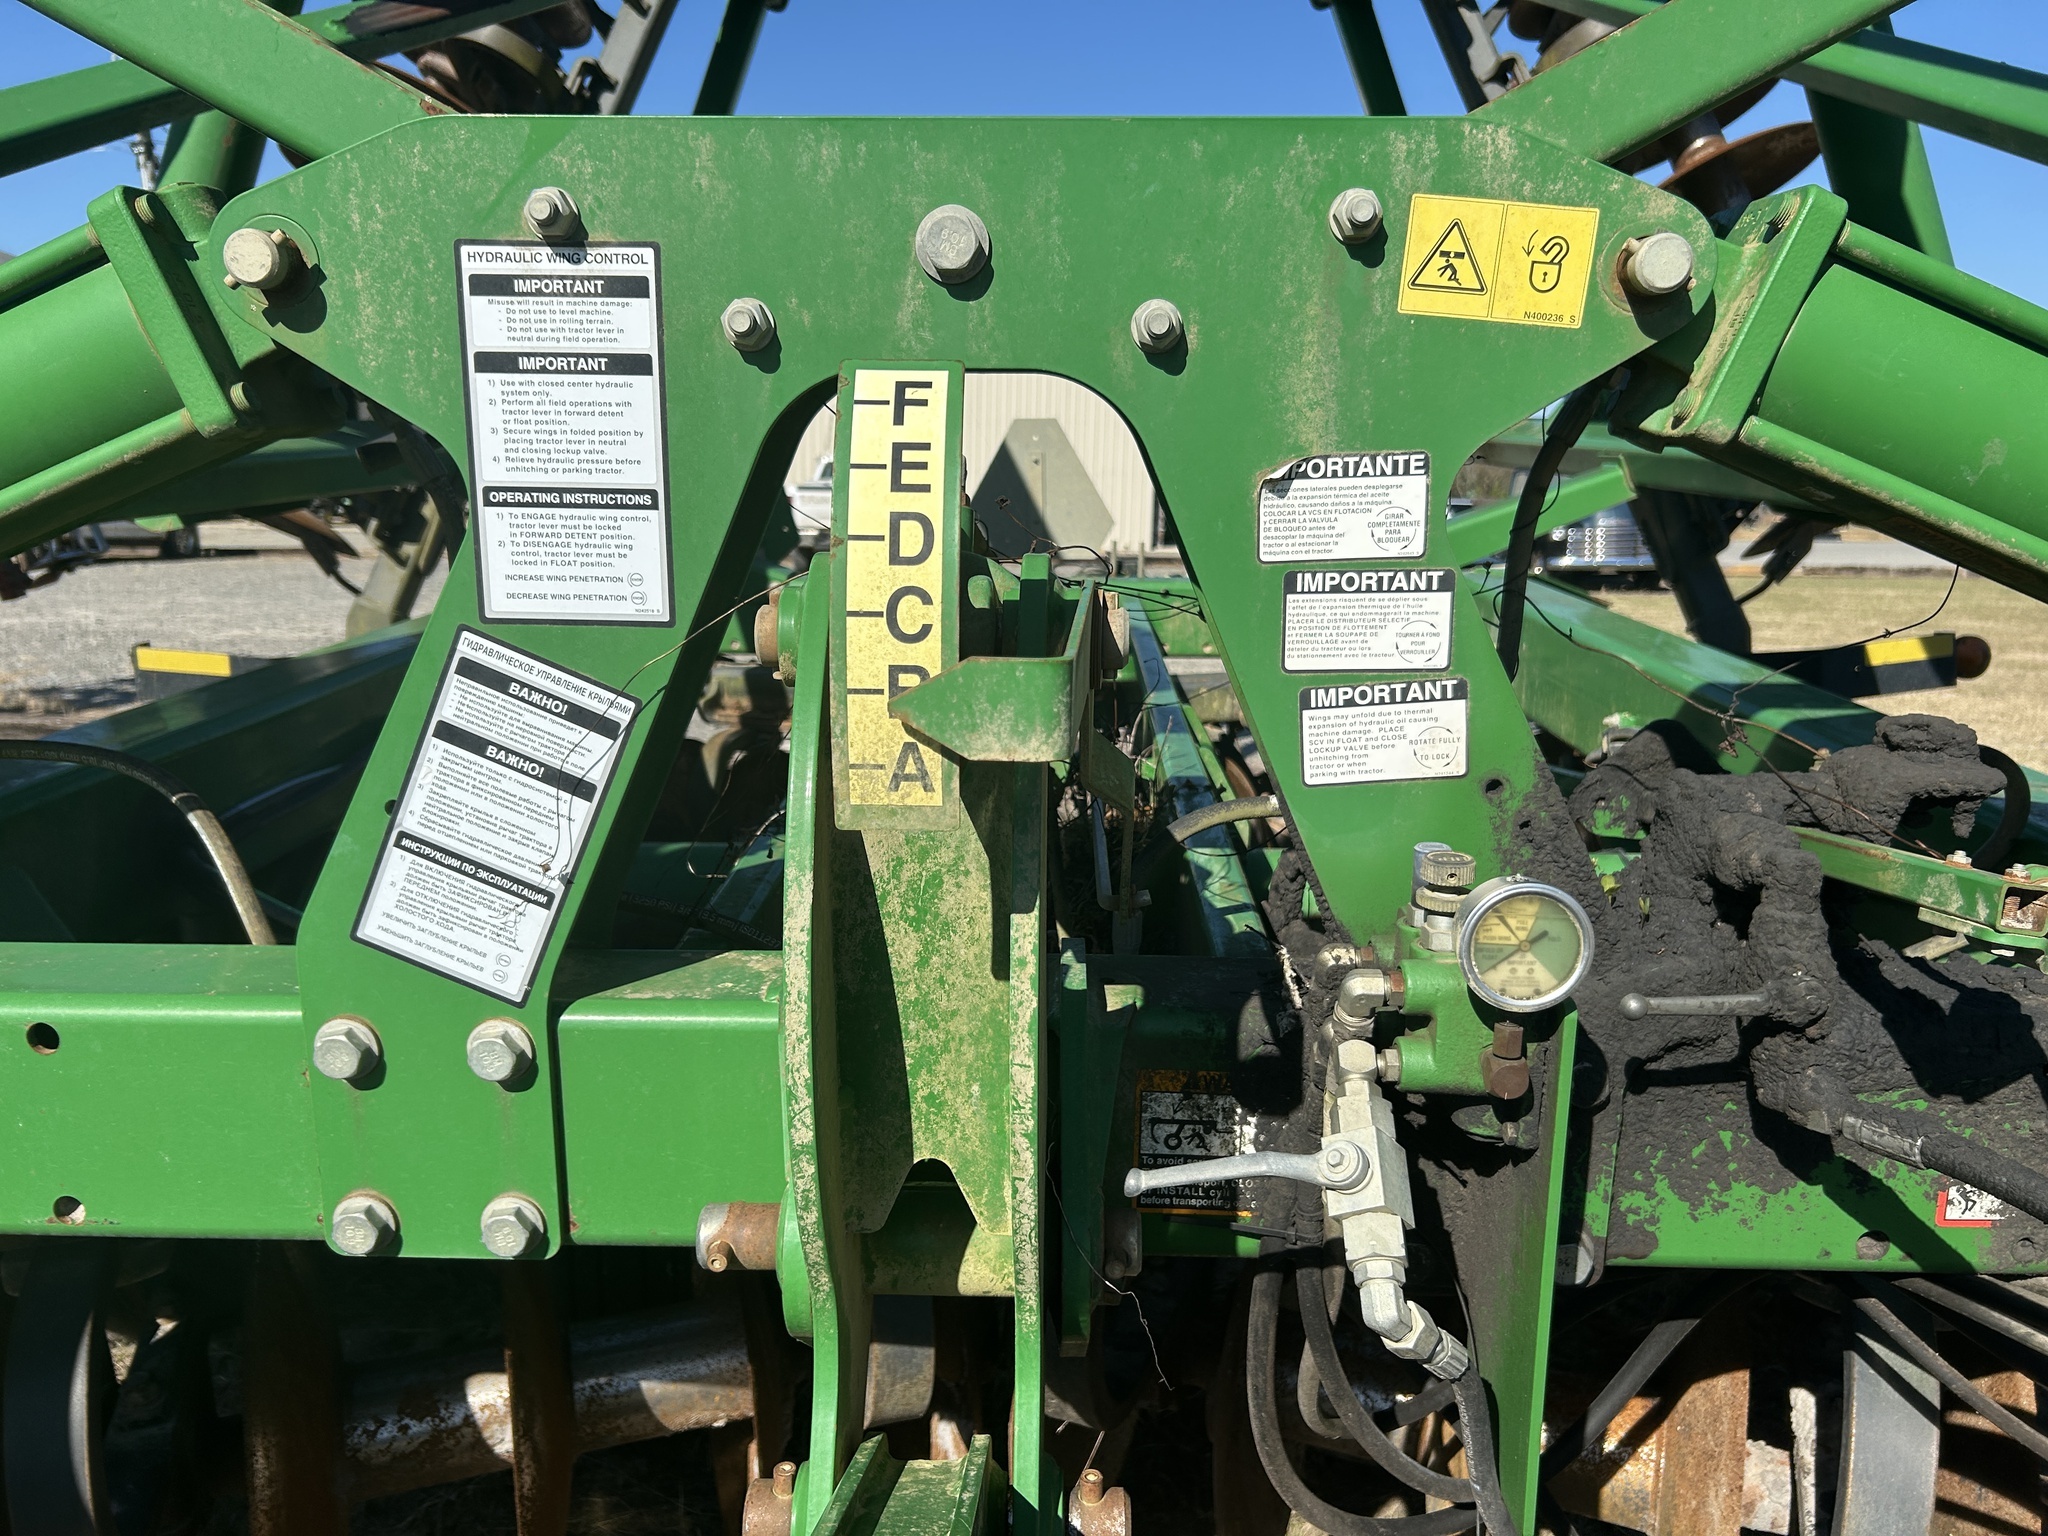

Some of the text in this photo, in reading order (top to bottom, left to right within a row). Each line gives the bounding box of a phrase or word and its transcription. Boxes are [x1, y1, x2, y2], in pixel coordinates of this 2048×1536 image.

[467, 251, 648, 264] HYDRAULIC WING CONTROL
[513, 278, 604, 294] IMPORTANT
[599, 300, 632, 308] damage:
[558, 317, 583, 326] rolling
[1524, 311, 1576, 324] N400236 S
[535, 335, 560, 343] during
[518, 356, 608, 370] IMPORTANT
[487, 378, 495, 387] 1)
[595, 380, 633, 389] hydraulic
[893, 381, 933, 426] F
[890, 442, 931, 492] E
[1284, 454, 1426, 479] PORTANTE
[488, 491, 652, 505] OPERATING INSTRUCTIONS
[496, 512, 503, 520] 1)
[558, 513, 596, 522] hydraulic
[598, 514, 617, 523] wing
[1367, 520, 1420, 528] COMPLETAMENTE
[889, 512, 934, 566] D
[568, 575, 623, 583] PENETRATION
[1296, 570, 1445, 592] IMPORTANT
[572, 593, 627, 601] PENETRATION
[886, 586, 933, 644] C
[462, 636, 632, 716] ГИДРАВЛИЧЕСКОЕ УПРАВЛЕНИЕ КРЫЛЬЯМИ
[507, 681, 568, 715] ВАЖНО!
[1310, 679, 1458, 708] IMPORTANT
[1358, 718, 1394, 727] hydraulic
[1380, 733, 1407, 741] CLOSE
[1408, 737, 1436, 745] ROTATE
[485, 744, 544, 777] ВАЖНО!
[888, 742, 935, 792] A
[400, 837, 547, 904] ИНСТРУКЦИИ ПО ЭКСПЛУАТАЦИИ
[1142, 1156, 1184, 1164] To avoid
[1157, 1187, 1205, 1196] INSTALL
[1140, 1196, 1230, 1208] before transporting
